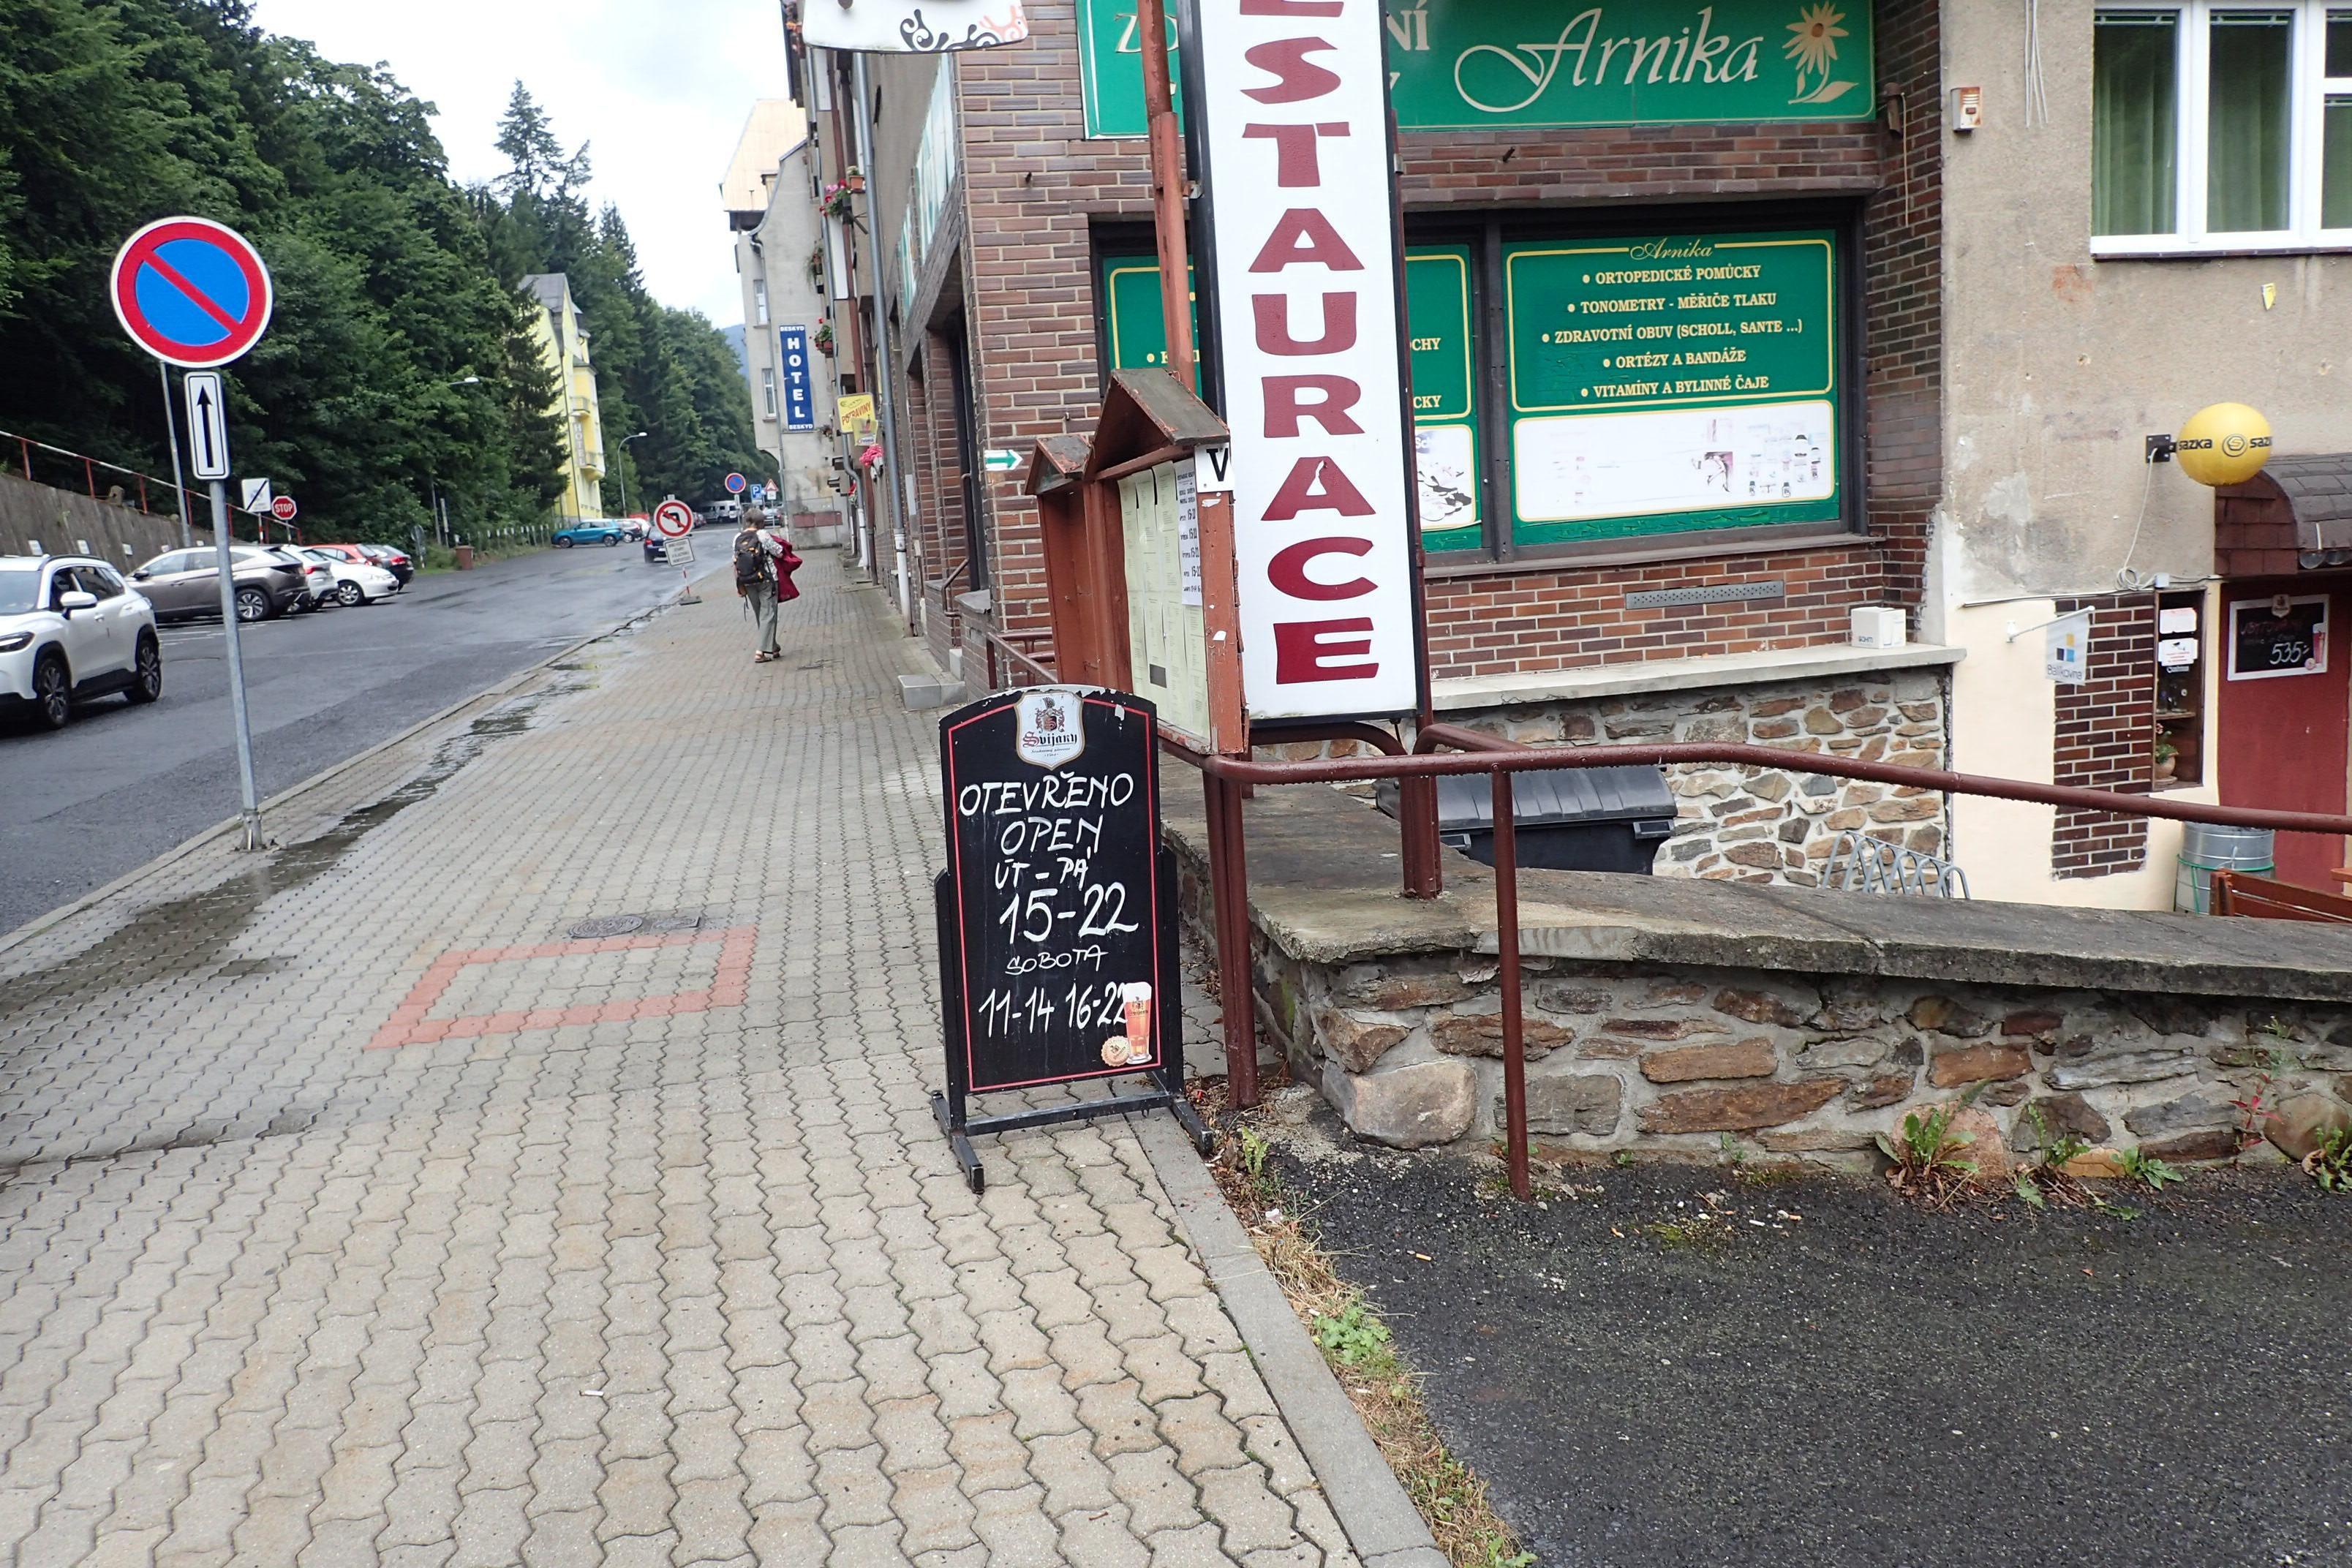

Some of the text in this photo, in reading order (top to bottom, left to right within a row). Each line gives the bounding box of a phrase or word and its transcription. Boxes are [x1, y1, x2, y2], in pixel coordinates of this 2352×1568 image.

[1455, 6, 1764, 113] Arnika
[1629, 238, 1714, 260] Arnika
[1595, 263, 1761, 284] ORTOPEDICKÉ POMŮCKY
[1580, 298, 1666, 314] TONOMETRY
[1678, 293, 1730, 309] MĚŘIČE
[1733, 293, 1777, 306] TLAKU
[1240, 0, 1379, 685] STAURACE
[1410, 338, 1441, 351] CHY
[1555, 324, 1633, 344] ZDRAVOTNÍ
[1637, 325, 1673, 339] OBUV
[1676, 323, 1736, 339] (SCHOLL,
[1740, 320, 1783, 333] SANTE
[1616, 347, 1746, 369] ORTÉZY A BANDÁŽE
[788, 337, 805, 418] HOTEL
[1593, 375, 1769, 397] VITAMÍNY A BYLINNÉ ČAJE
[842, 402, 871, 426] POTRAVINY
[573, 423, 585, 465] HOTEL
[2179, 439, 2212, 451] sazka
[1206, 448, 1229, 482] V
[274, 503, 293, 513] STOP
[1022, 731, 1077, 747] Svijany
[960, 771, 1134, 816] OTEVŘENO
[1000, 814, 1104, 855] OPEN
[995, 859, 1030, 889] ÚT
[1057, 846, 1091, 891] PÁ
[1000, 882, 1139, 944] 15-22
[1005, 944, 1109, 976] SOBOTA
[979, 981, 1128, 1038] 11-14 16-22
